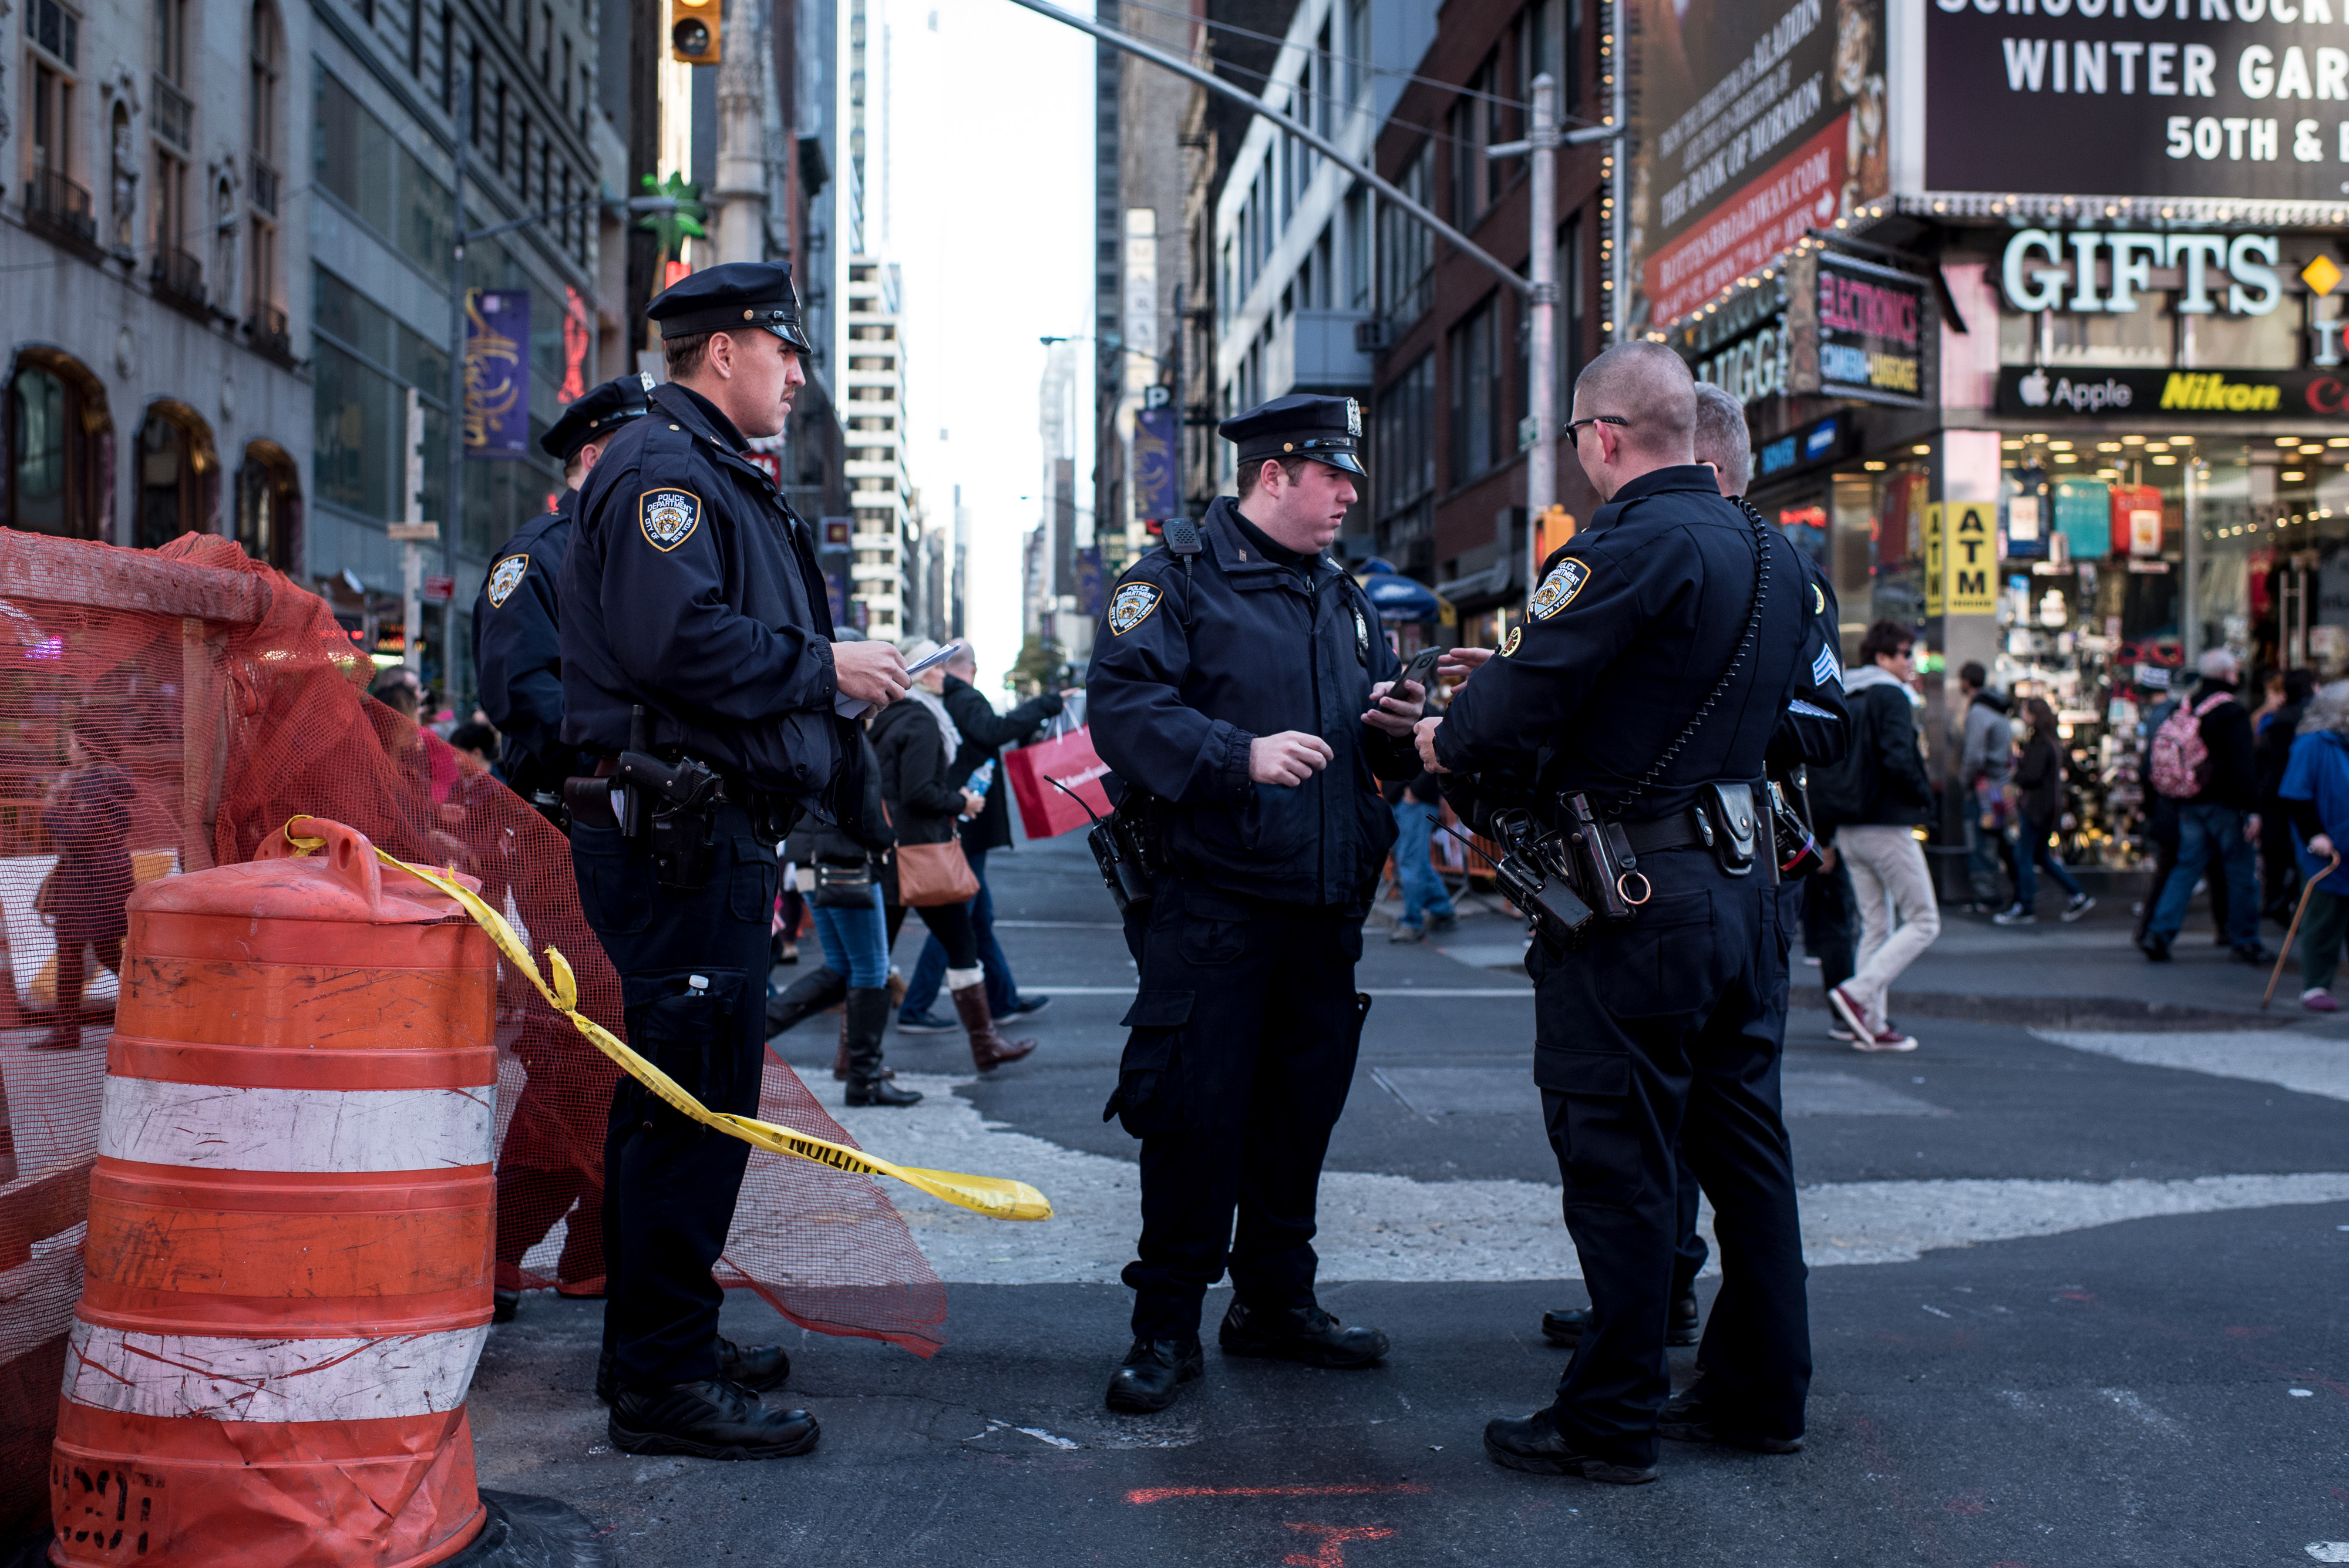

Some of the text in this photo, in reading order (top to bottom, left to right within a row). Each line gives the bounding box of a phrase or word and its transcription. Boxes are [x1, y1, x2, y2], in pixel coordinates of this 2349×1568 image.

[2003, 38, 2216, 97] WINTER
[2166, 116, 2278, 161] 50TH
[2293, 119, 2324, 162] &
[1727, 131, 1749, 177] OF
[2003, 229, 2283, 316] GIFTS
[1147, 386, 1170, 408] P
[2052, 378, 2132, 411] Apple
[2159, 374, 2281, 410] Nikon
[647, 501, 693, 514] DEPARTMENT
[658, 494, 685, 503] POLICE
[645, 518, 654, 531] CITY
[671, 517, 694, 543] NEW YORK
[1959, 508, 1984, 594] ATM
[1547, 568, 1580, 586] ARTMENT
[1116, 590, 1156, 601] DEPARTMENT
[1538, 607, 1553, 620] NEW
[1554, 590, 1575, 608] YORK
[1124, 604, 1153, 629] NEW YORK
[789, 1138, 887, 1175] UTION
